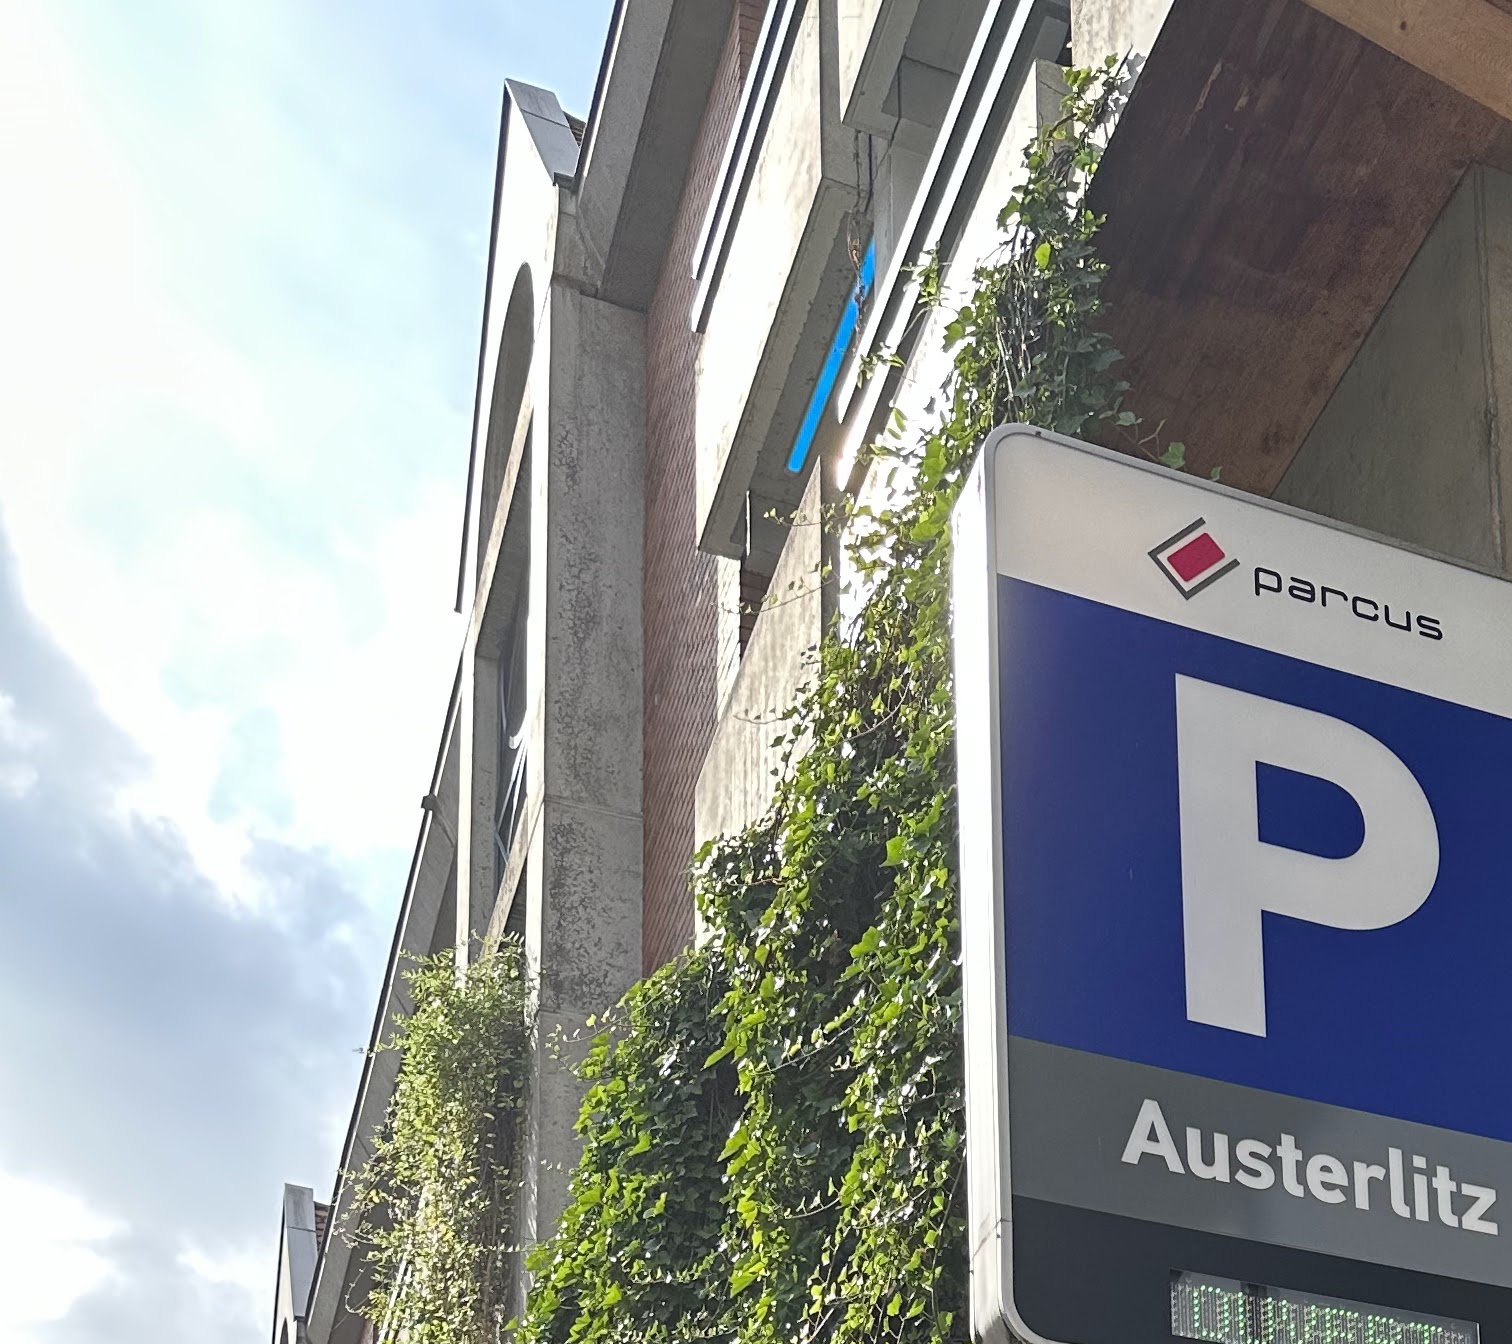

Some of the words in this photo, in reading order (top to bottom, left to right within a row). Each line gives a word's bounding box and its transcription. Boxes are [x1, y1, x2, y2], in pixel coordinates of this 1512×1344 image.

[1253, 566, 1443, 641] parcus
[1175, 672, 1440, 1038] P
[1120, 1098, 1499, 1236] Austerlitz
